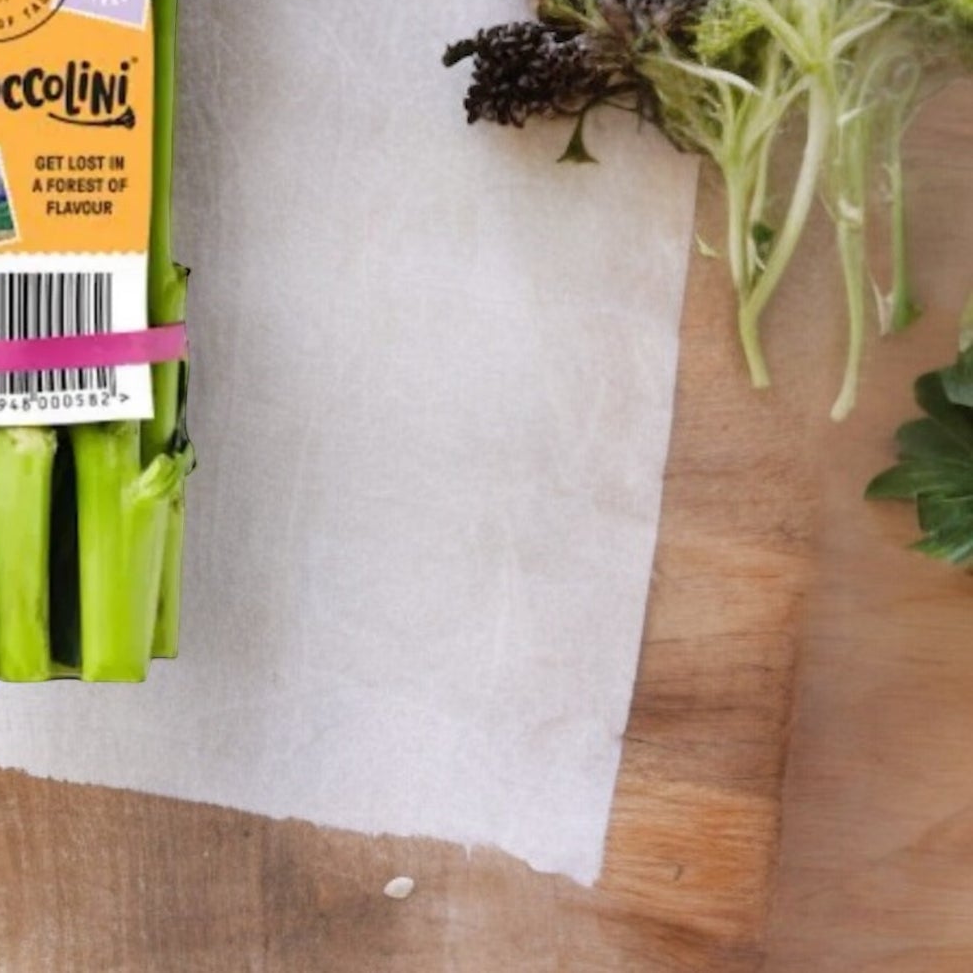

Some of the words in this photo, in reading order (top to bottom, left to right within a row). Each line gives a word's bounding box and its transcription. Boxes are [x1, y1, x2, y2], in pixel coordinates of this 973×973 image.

[34, 155, 63, 171] GET
[68, 155, 104, 171] LOST
[109, 155, 125, 171] IN
[32, 178, 43, 193] A
[46, 177, 103, 193] FOREST
[108, 177, 128, 193] OF
[46, 200, 113, 215] FLAVOUR
